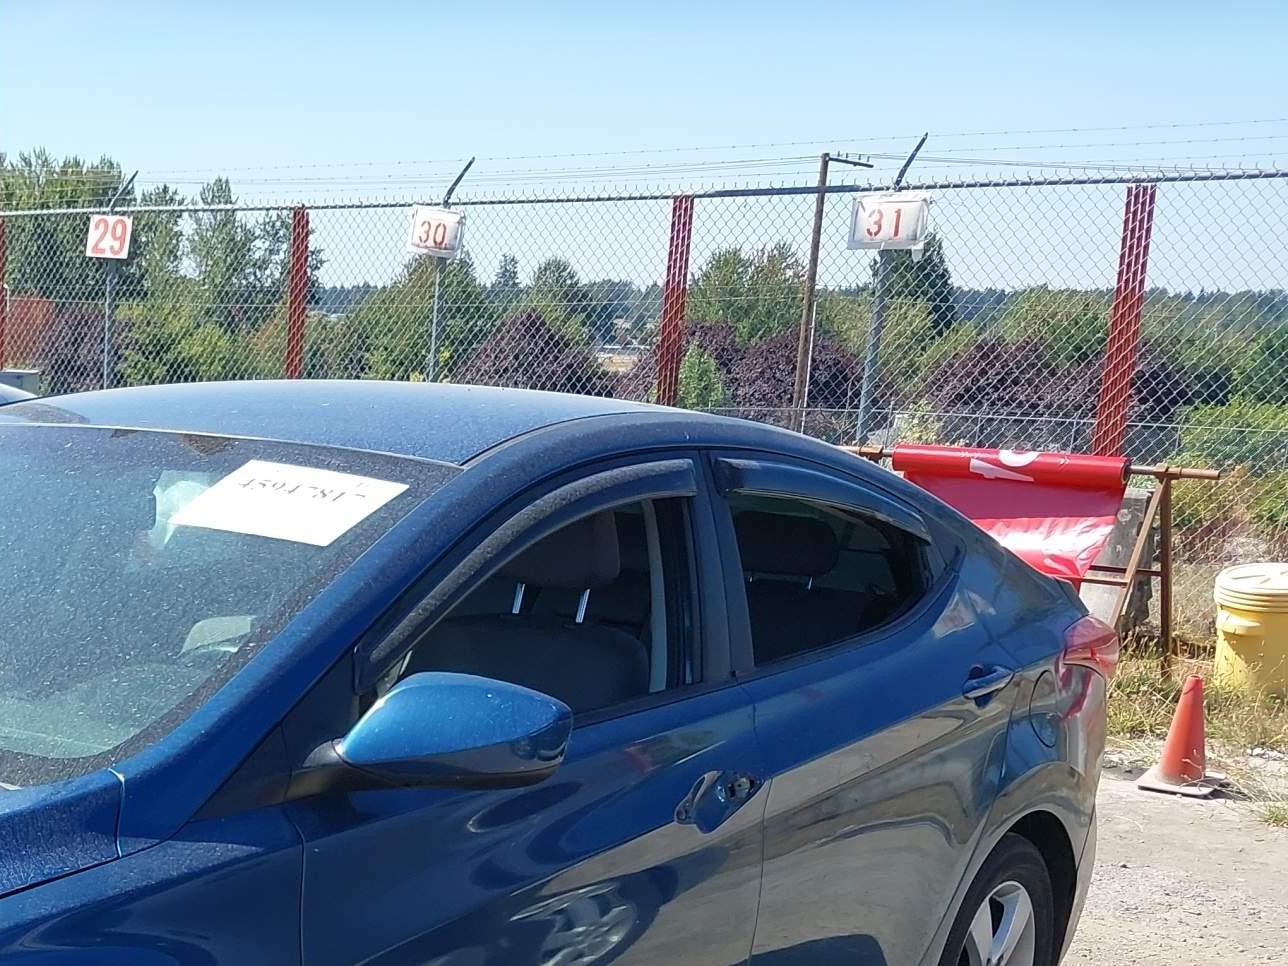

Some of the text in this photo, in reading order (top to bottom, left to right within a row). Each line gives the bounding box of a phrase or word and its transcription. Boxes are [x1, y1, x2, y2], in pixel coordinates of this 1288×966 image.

[92, 218, 127, 256] 29
[419, 220, 448, 248] 30
[867, 208, 902, 239] 31
